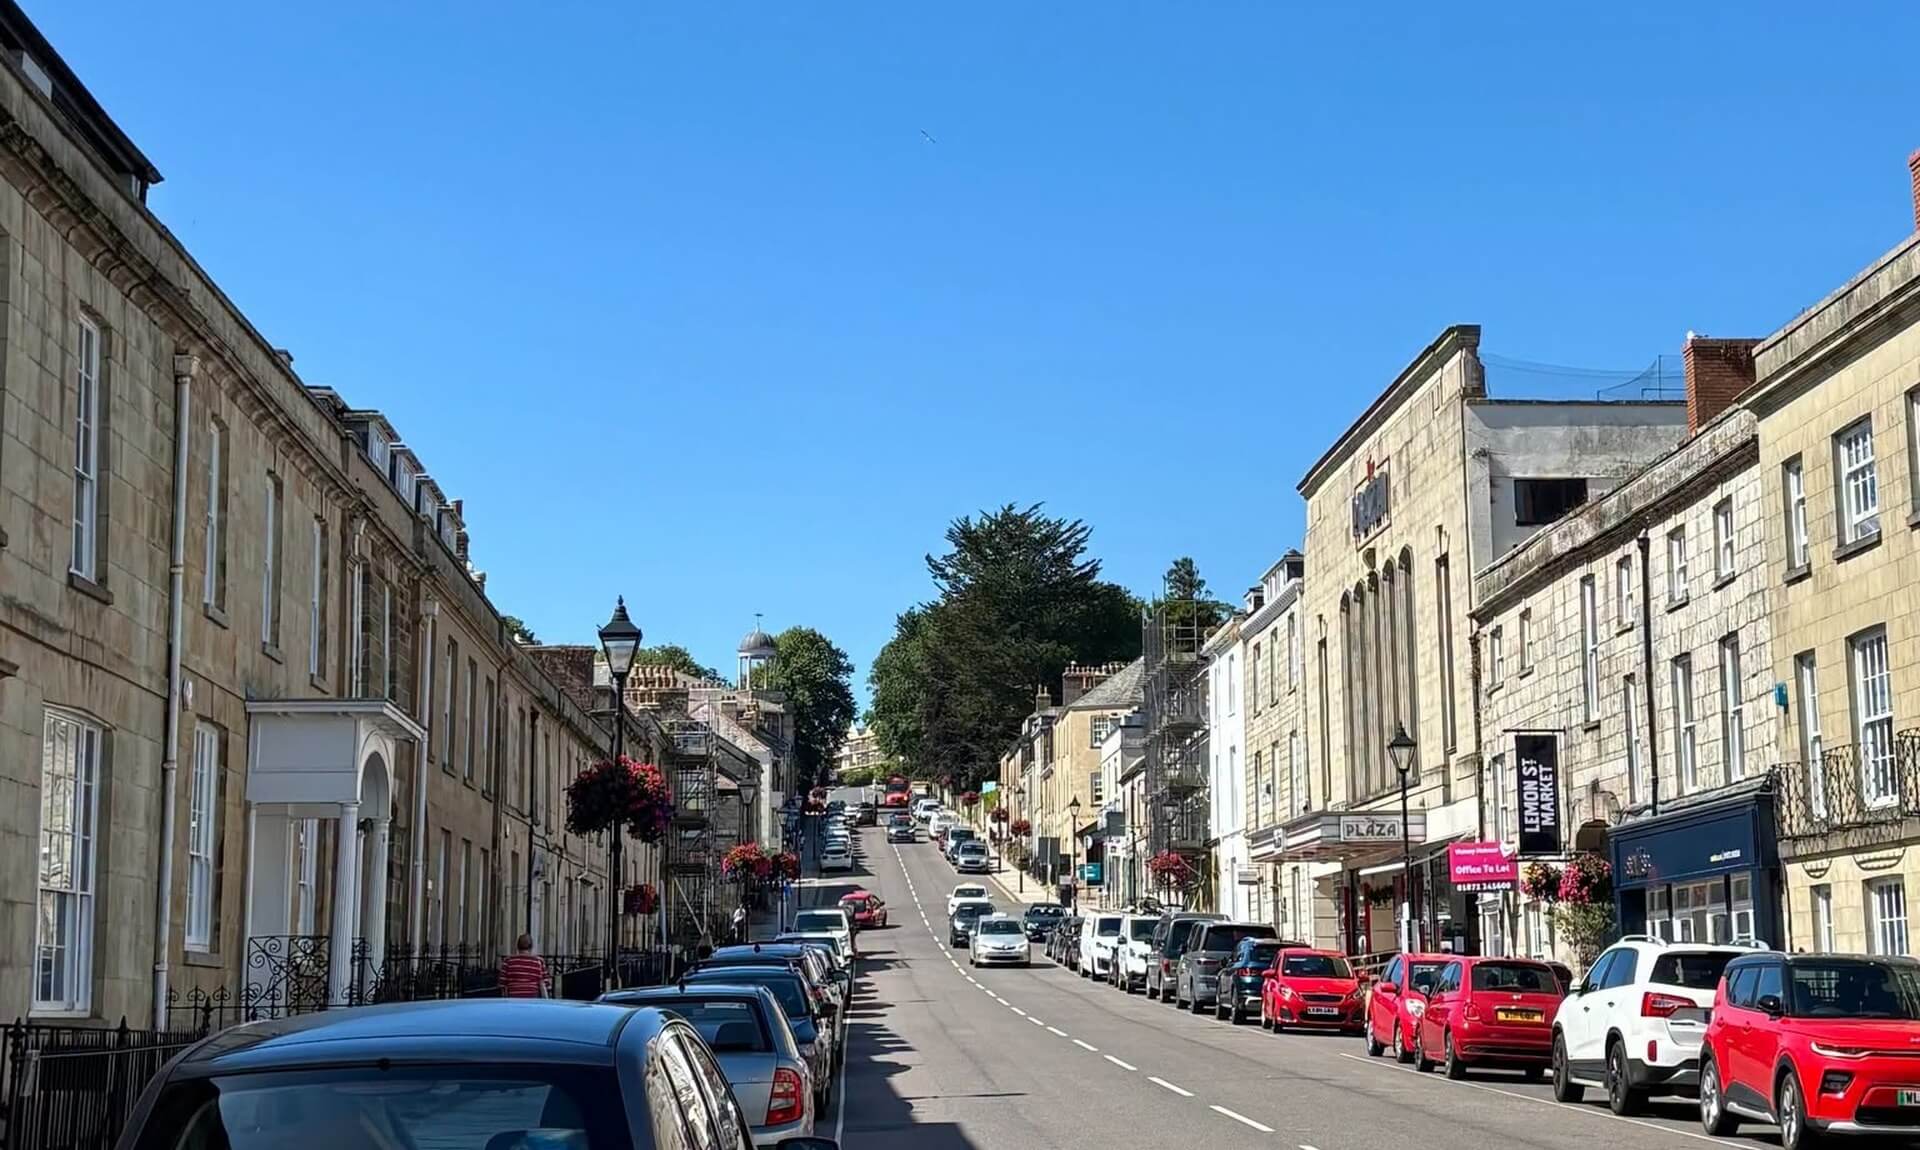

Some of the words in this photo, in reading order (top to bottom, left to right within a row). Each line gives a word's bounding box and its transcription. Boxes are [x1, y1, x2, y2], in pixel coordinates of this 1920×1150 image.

[1522, 780, 1540, 833] LEMON
[1539, 764, 1556, 826] MARKET
[1345, 823, 1397, 837] PLAZA
[1455, 865, 1482, 874] Office
[1482, 864, 1494, 873] To
[1495, 864, 1510, 873] Let
